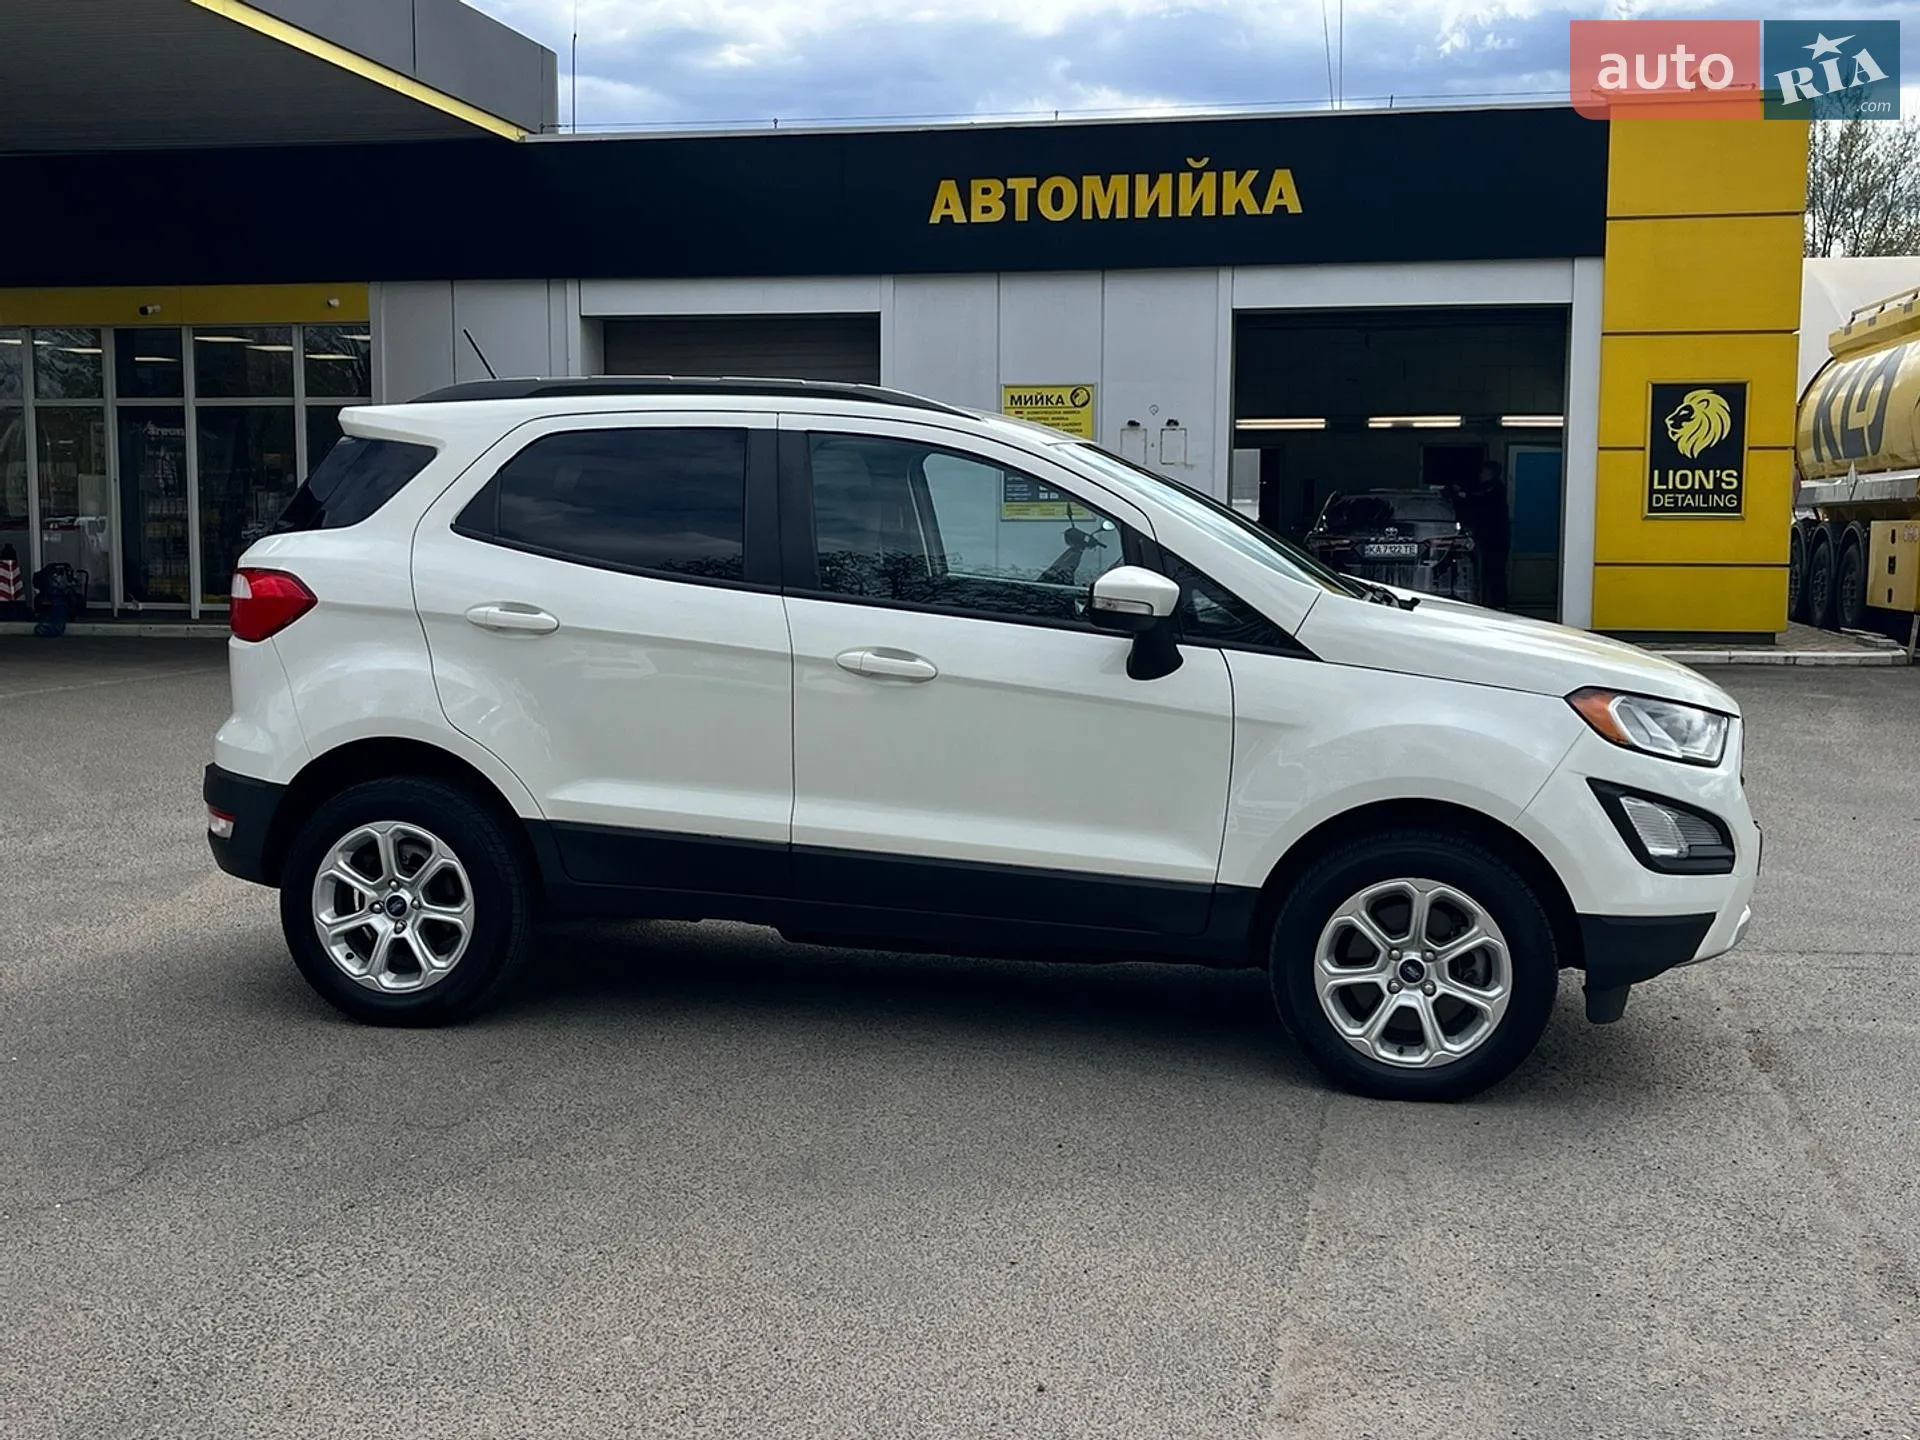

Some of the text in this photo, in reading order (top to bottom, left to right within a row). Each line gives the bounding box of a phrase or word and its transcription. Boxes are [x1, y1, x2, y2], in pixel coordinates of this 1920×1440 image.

[928, 157, 1303, 225] АВТОМИЙКА
[1010, 391, 1065, 406] МИЙКА
[1653, 469, 1739, 490] LION'S
[1652, 494, 1738, 508] DETAILING
